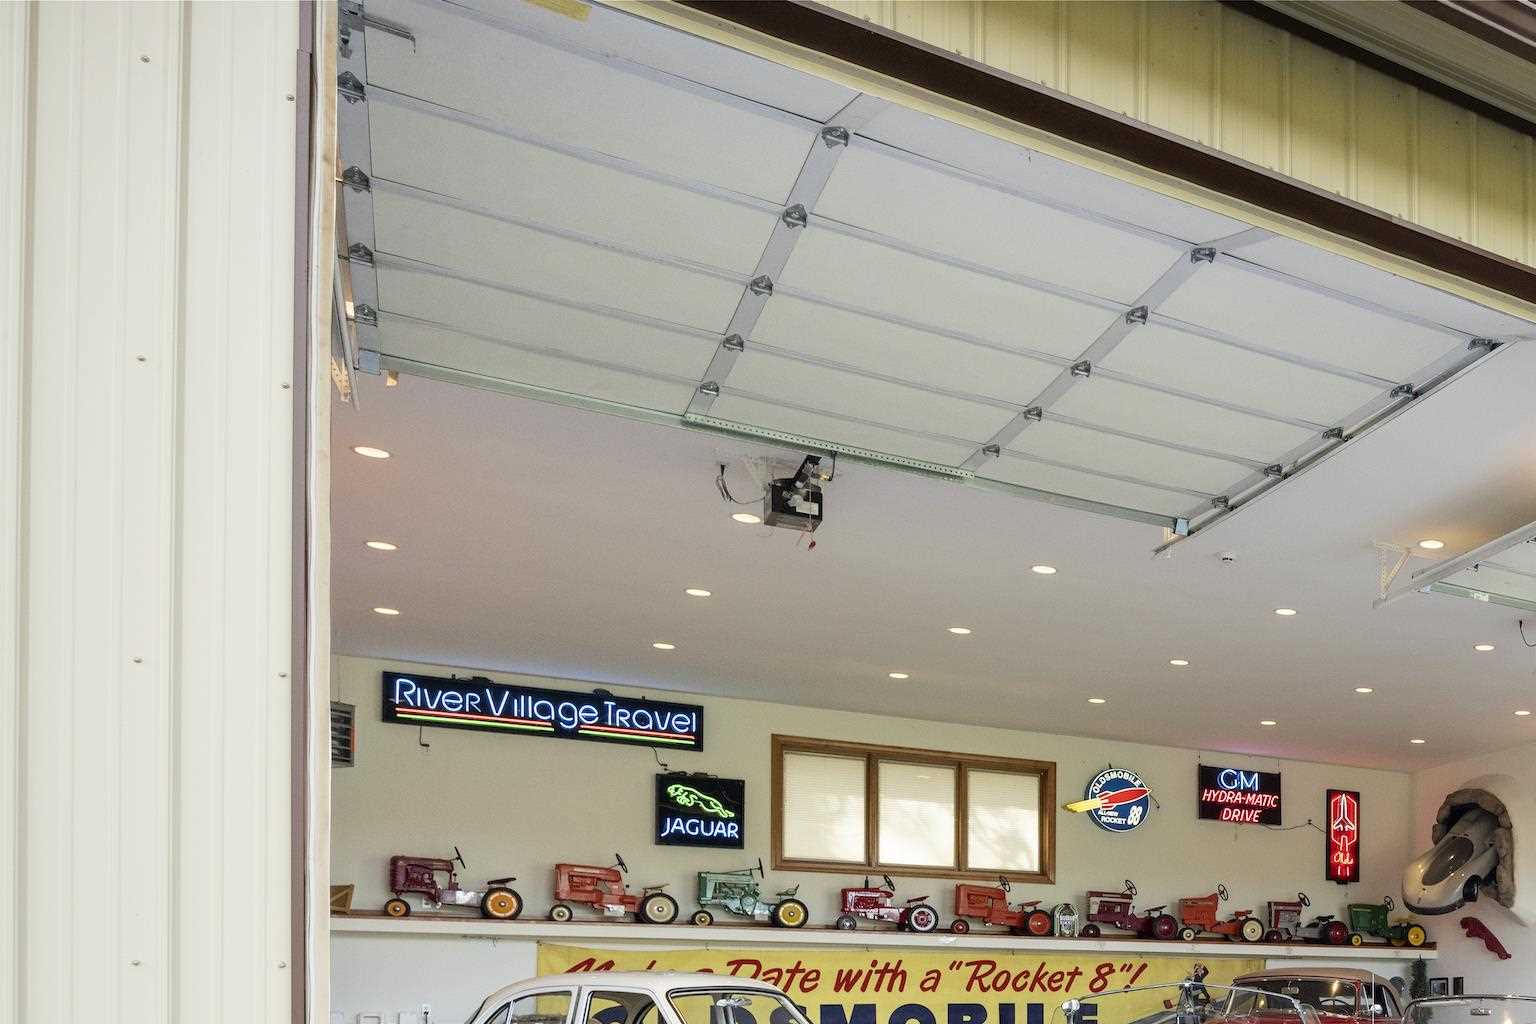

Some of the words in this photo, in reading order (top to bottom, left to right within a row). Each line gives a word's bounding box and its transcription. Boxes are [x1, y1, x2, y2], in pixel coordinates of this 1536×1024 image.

[395, 678, 481, 713] River
[486, 688, 599, 730] Village
[603, 700, 696, 733] Travel
[1092, 770, 1143, 794] OLDSMOBILE
[1219, 768, 1259, 791] GM
[1202, 788, 1279, 808] HYDRA-MATIC
[1101, 815, 1127, 825] ROCKET
[1127, 805, 1143, 826] 88
[1222, 807, 1263, 823] DRIVE
[660, 816, 739, 840] JAGUAR
[726, 958, 822, 994] Date
[833, 958, 908, 993] with
[919, 967, 942, 993] a
